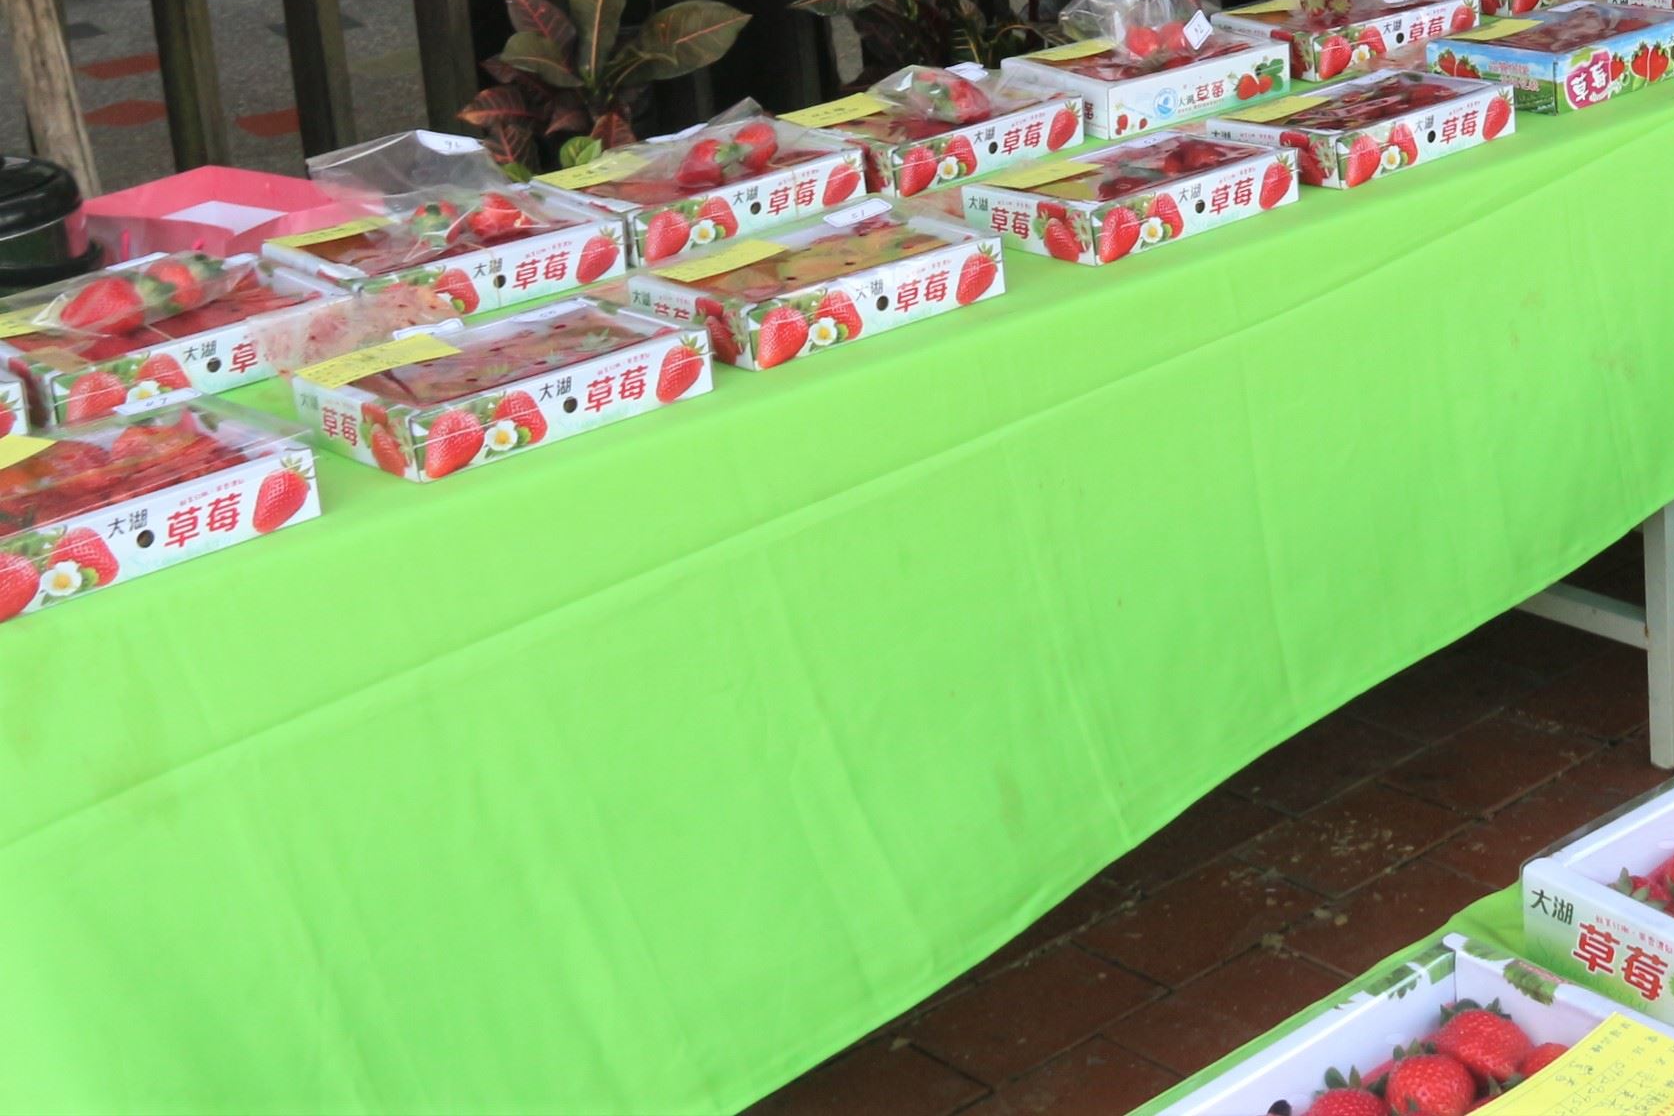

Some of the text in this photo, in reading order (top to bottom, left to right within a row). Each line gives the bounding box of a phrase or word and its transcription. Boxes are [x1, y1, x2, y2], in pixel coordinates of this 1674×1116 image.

[1408, 16, 1445, 43] 草莓
[1002, 122, 1044, 154] 草莓
[1439, 109, 1477, 145] 草莓
[768, 179, 817, 215] 草莓
[1210, 177, 1254, 214] 草莓
[990, 205, 1031, 239] 草莓
[513, 251, 569, 290] 草莓
[894, 270, 949, 312] 草莓
[583, 367, 646, 413] 草莓
[321, 404, 359, 446] 草莓
[107, 493, 243, 548] 大湖 草莓
[1530, 888, 1669, 1001] 大湖 草莓
